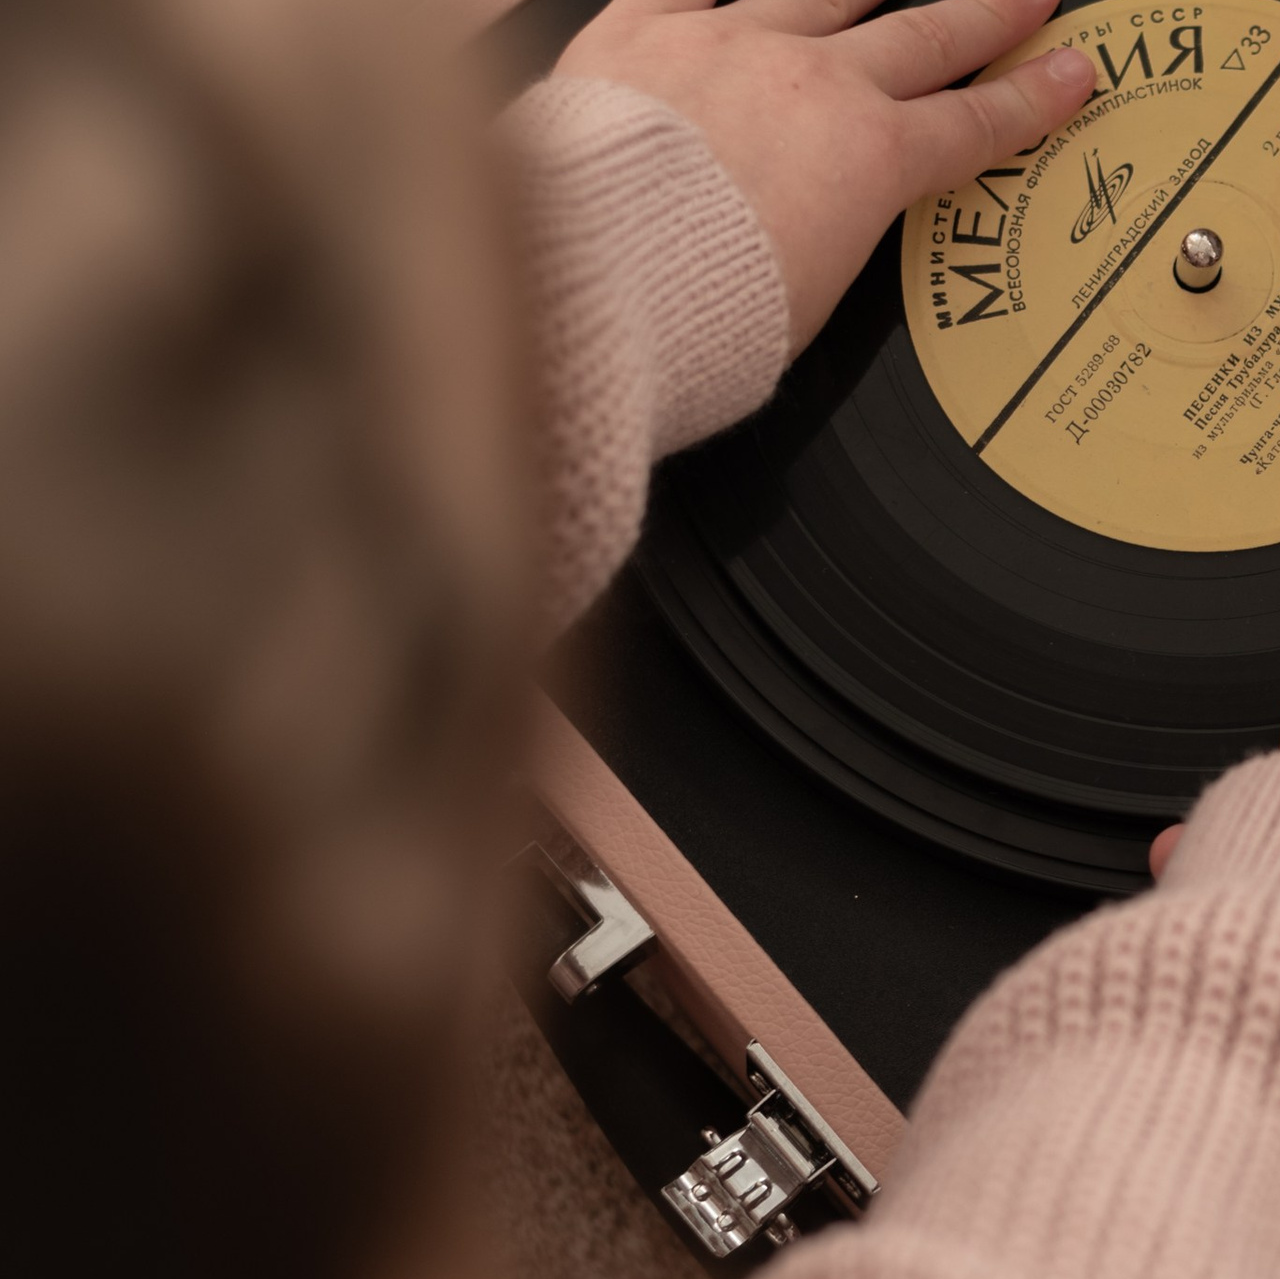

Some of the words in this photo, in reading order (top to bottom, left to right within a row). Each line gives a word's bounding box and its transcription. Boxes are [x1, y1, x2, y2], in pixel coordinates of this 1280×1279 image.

[1130, 7, 1204, 28] СССР
[1240, 25, 1270, 55] 33
[948, 25, 1204, 326] МЕЛИЯ
[1005, 193, 1032, 312] ВСЕСОЮЗНАЯ
[1026, 137, 1069, 190] ФИРМА
[1066, 77, 1203, 143] ГРАМПЛАСТИНОК
[1262, 140, 1279, 156] 2
[1071, 189, 1168, 309] ЛЕНИНГРАДСКИЙ
[1169, 138, 1212, 186] ЗАВОД
[1044, 384, 1077, 423] ГОСТ
[1075, 334, 1120, 386] 5289-68
[1065, 343, 1151, 445] Д-00030782
[1183, 353, 1240, 421] ПЕСЕНКИ
[1243, 326, 1262, 346] ИЗ
[1192, 444, 1207, 459] из
[1207, 361, 1273, 441] мультфильма
[1194, 393, 1229, 430] Песня
